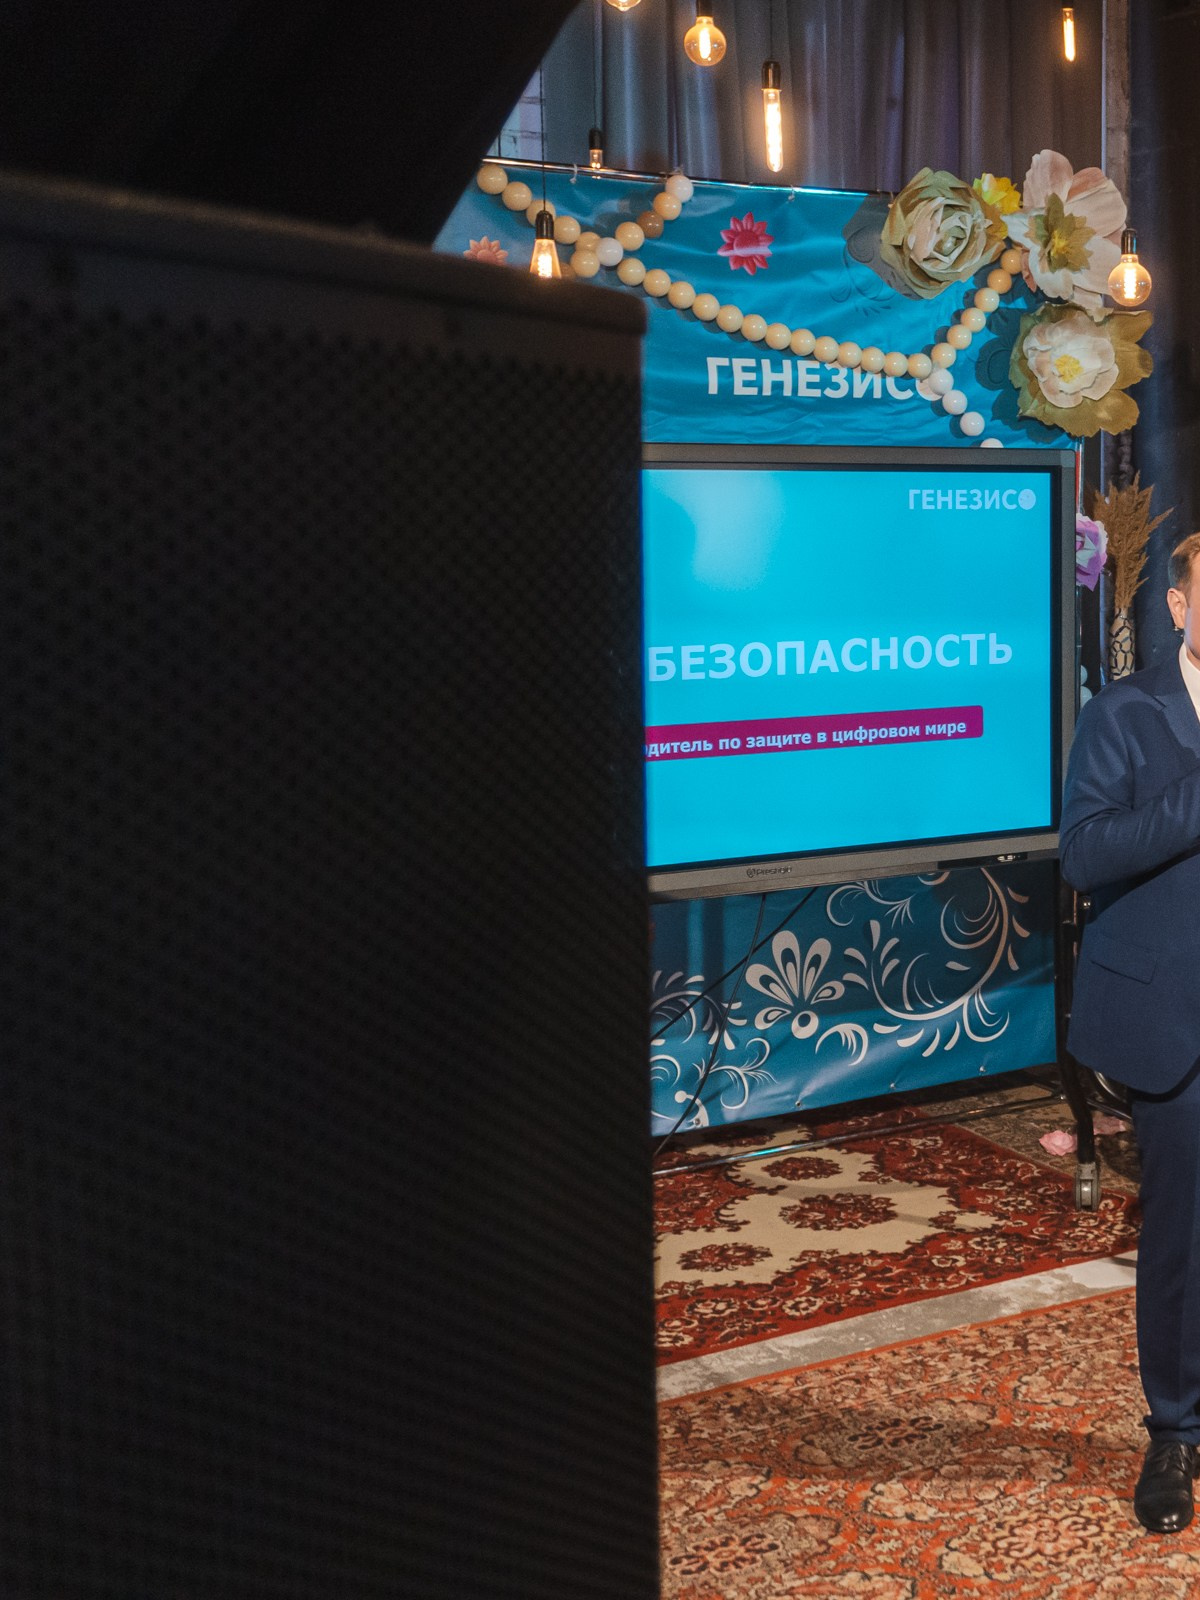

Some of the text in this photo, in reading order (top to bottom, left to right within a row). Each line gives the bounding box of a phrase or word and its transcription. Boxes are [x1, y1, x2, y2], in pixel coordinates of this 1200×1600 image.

[648, 632, 1013, 682] БЕЗОПАСНОСТЬ
[718, 737, 741, 751] по
[745, 732, 812, 748] защите
[816, 732, 827, 743] в
[832, 725, 920, 744] цифровом
[925, 721, 967, 737] мире
